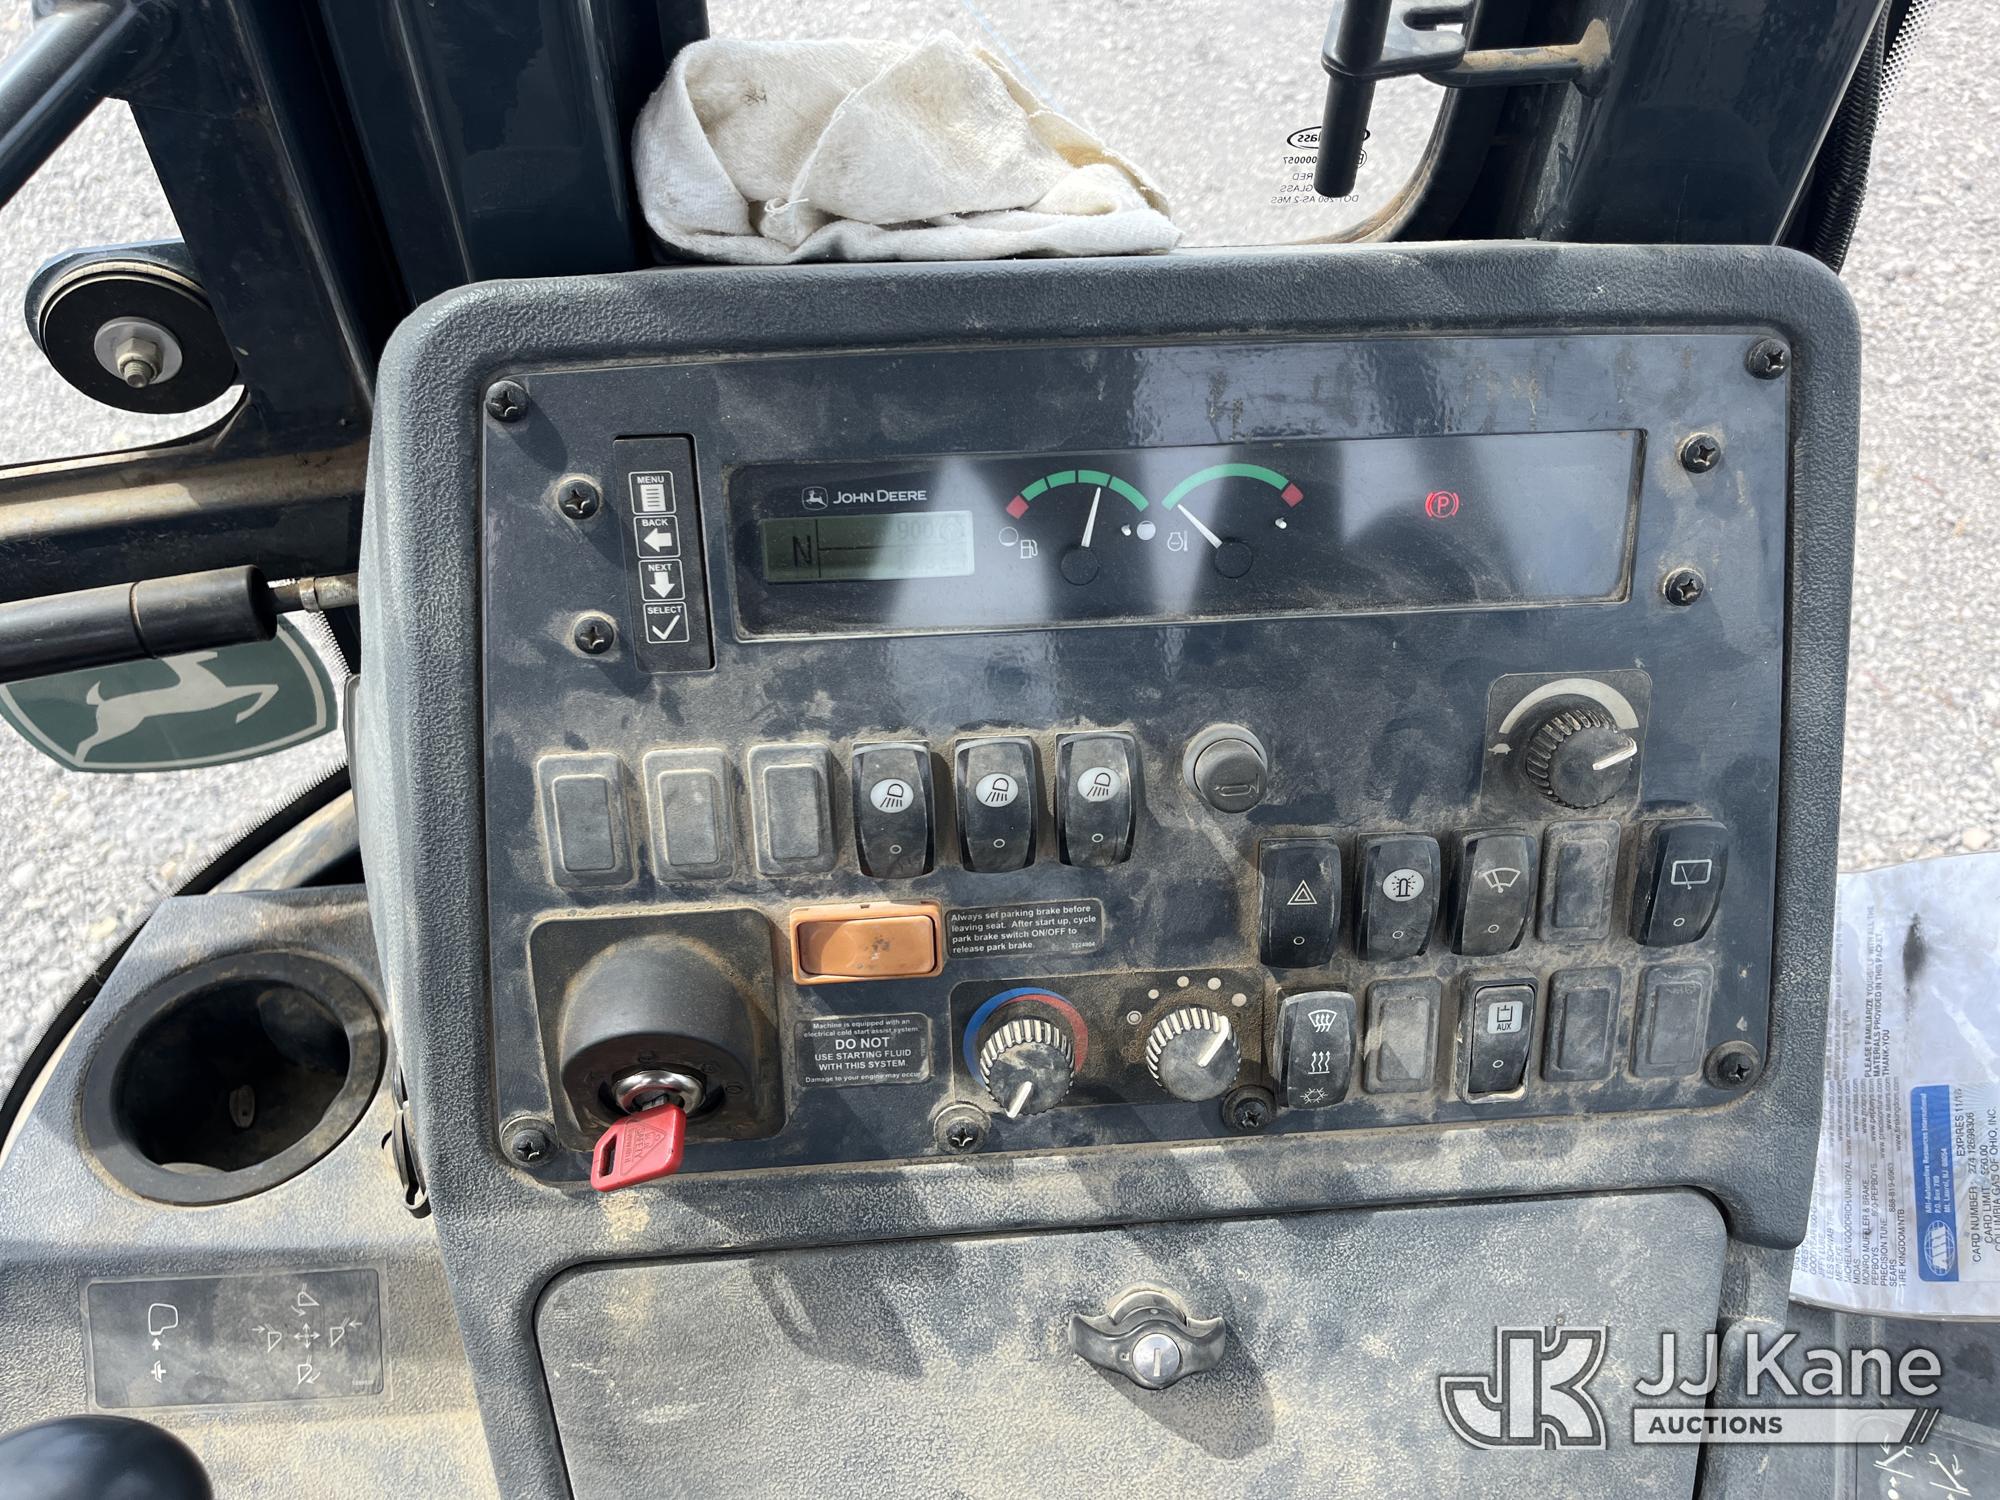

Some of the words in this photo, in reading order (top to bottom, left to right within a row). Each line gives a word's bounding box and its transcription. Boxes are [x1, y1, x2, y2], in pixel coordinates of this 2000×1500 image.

[637, 476, 664, 484] MENU
[833, 490, 875, 505] JOHN
[877, 489, 927, 502] DEERE
[642, 518, 668, 527] BACK
[648, 563, 672, 572] NEXT
[647, 605, 682, 615] SELECT
[951, 912, 983, 923] Always
[985, 911, 999, 919] set
[1001, 908, 1034, 920] parking
[1036, 906, 1060, 916] brake
[1063, 905, 1091, 914] before
[951, 922, 984, 935] leaving
[986, 921, 1006, 930] seat.
[1011, 919, 1033, 928] After
[1035, 917, 1055, 926] start
[1057, 917, 1071, 926] up,
[1073, 915, 1096, 926] cycle
[952, 935, 976, 945] park
[978, 933, 999, 942] brake
[1001, 930, 1029, 939] switch
[1031, 927, 1066, 937] ON/OFF
[1068, 927, 1077, 935] to
[953, 943, 984, 953] release
[986, 942, 1006, 953] park
[1875, 982, 1882, 990] IN
[1873, 991, 1882, 1030] PROVIDED
[852, 1020, 884, 1028] equipped
[1496, 1021, 1512, 1032] AUX
[1865, 998, 1873, 1044] FAMILIARIZE
[835, 1039, 856, 1050] DO
[861, 1037, 890, 1048] NOT
[1882, 1029, 1890, 1076] THANK-YOU
[836, 1051, 882, 1060] STARTING
[885, 1049, 911, 1057] FLUID
[1873, 1032, 1881, 1077] MATERIALS
[819, 1063, 842, 1071] WITH
[1920, 1093, 1929, 1131] International
[1954, 1114, 1966, 1156] EXPIRES
[1990, 1158, 1999, 1172] OF
[1991, 1174, 2000, 1197] GAS
[1862, 1215, 1872, 1252] MUFFLER
[1983, 1214, 1993, 1243] CARD
[1970, 1232, 1982, 1262] CARD
[1862, 1254, 1870, 1285] MONRO
[1871, 1246, 1879, 1286] PEPBOYS
[1880, 1241, 1888, 1286] PRECISION
[1889, 1259, 1897, 1287] SEARS
[1898, 1269, 1906, 1287] TIRE
